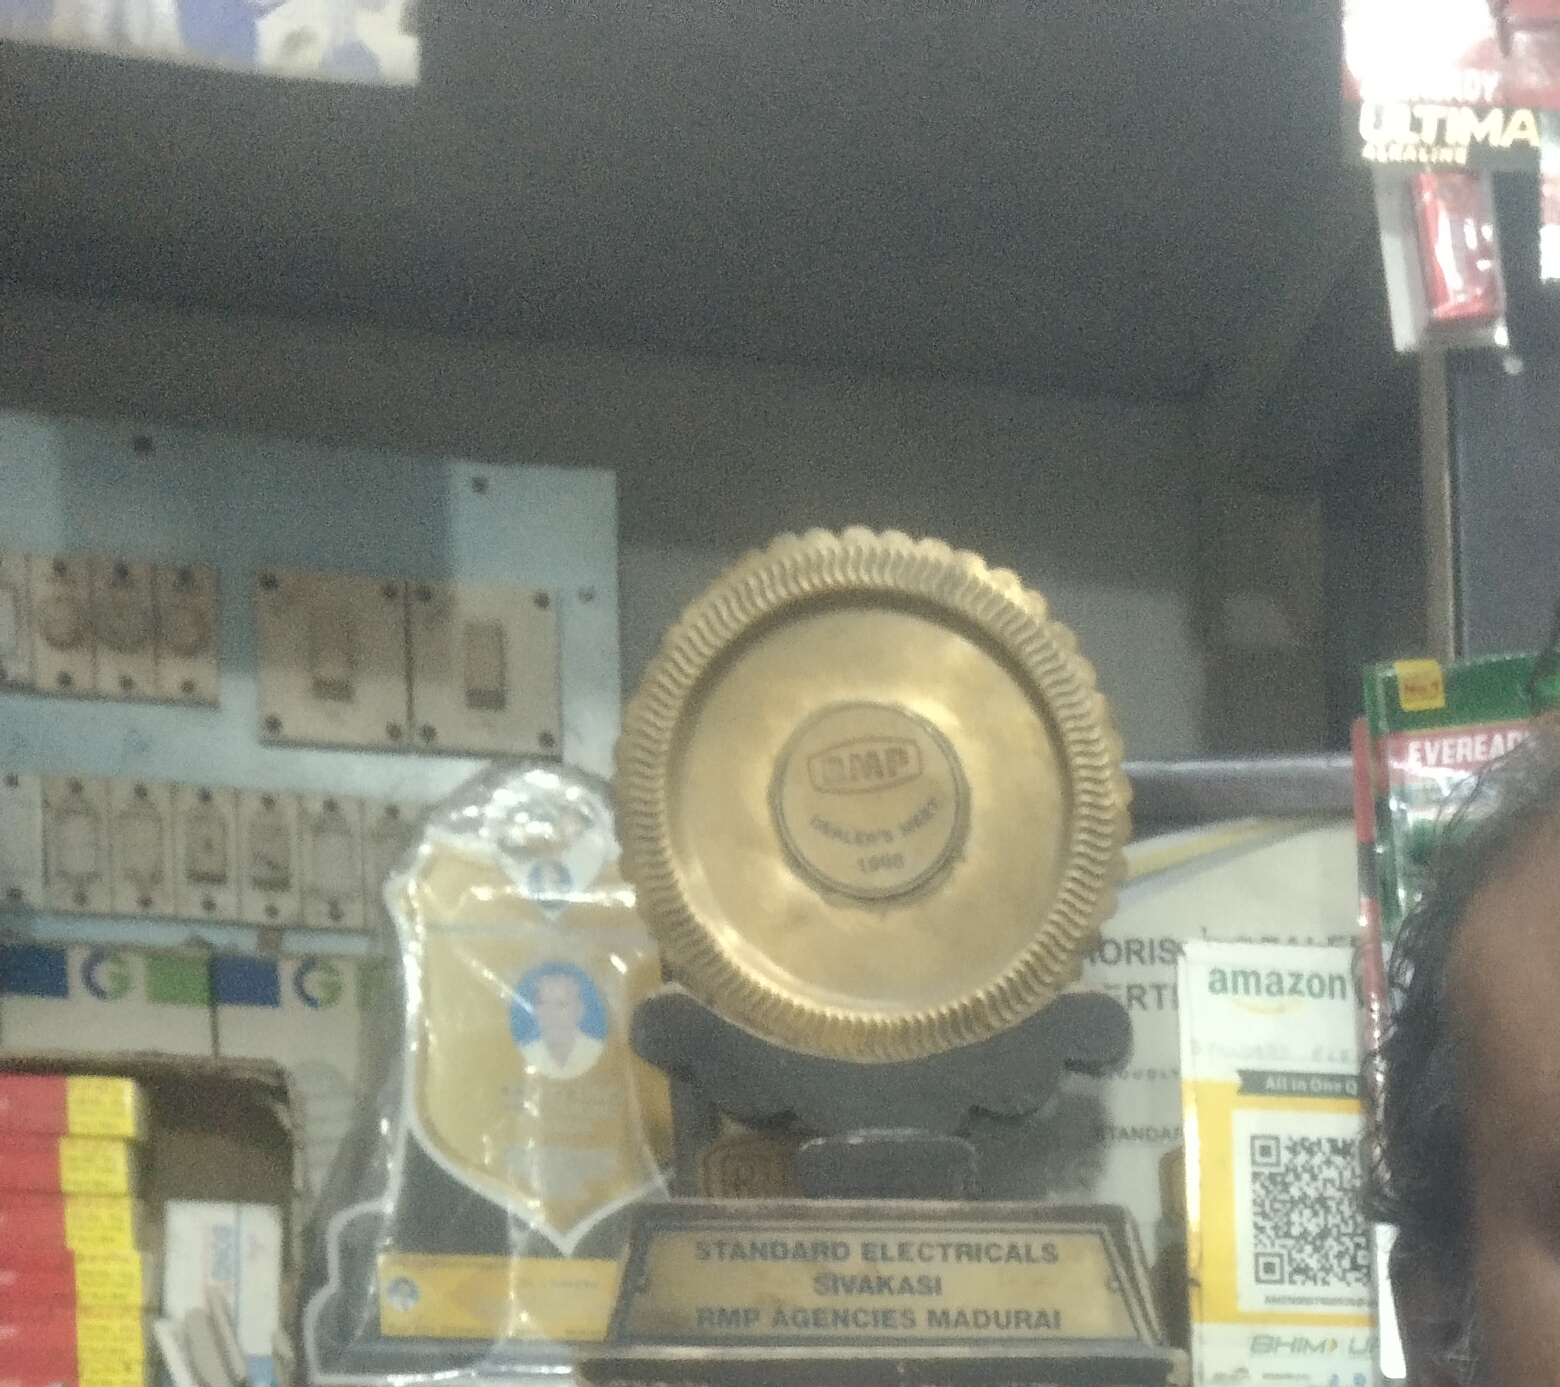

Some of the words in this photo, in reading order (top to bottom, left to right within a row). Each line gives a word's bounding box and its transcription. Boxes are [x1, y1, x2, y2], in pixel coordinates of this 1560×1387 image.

[1359, 101, 1540, 148] ULTIMA
[1406, 728, 1534, 764] EVEREAD
[1207, 967, 1348, 1001] amazon
[694, 1240, 851, 1264] STANDARD
[861, 1241, 1060, 1266] ELECTRICALS
[812, 1273, 943, 1297] SIVAKASI
[695, 1306, 762, 1331] RMP
[770, 1307, 918, 1331] AGENCIES
[927, 1308, 1063, 1331] MADURAI
